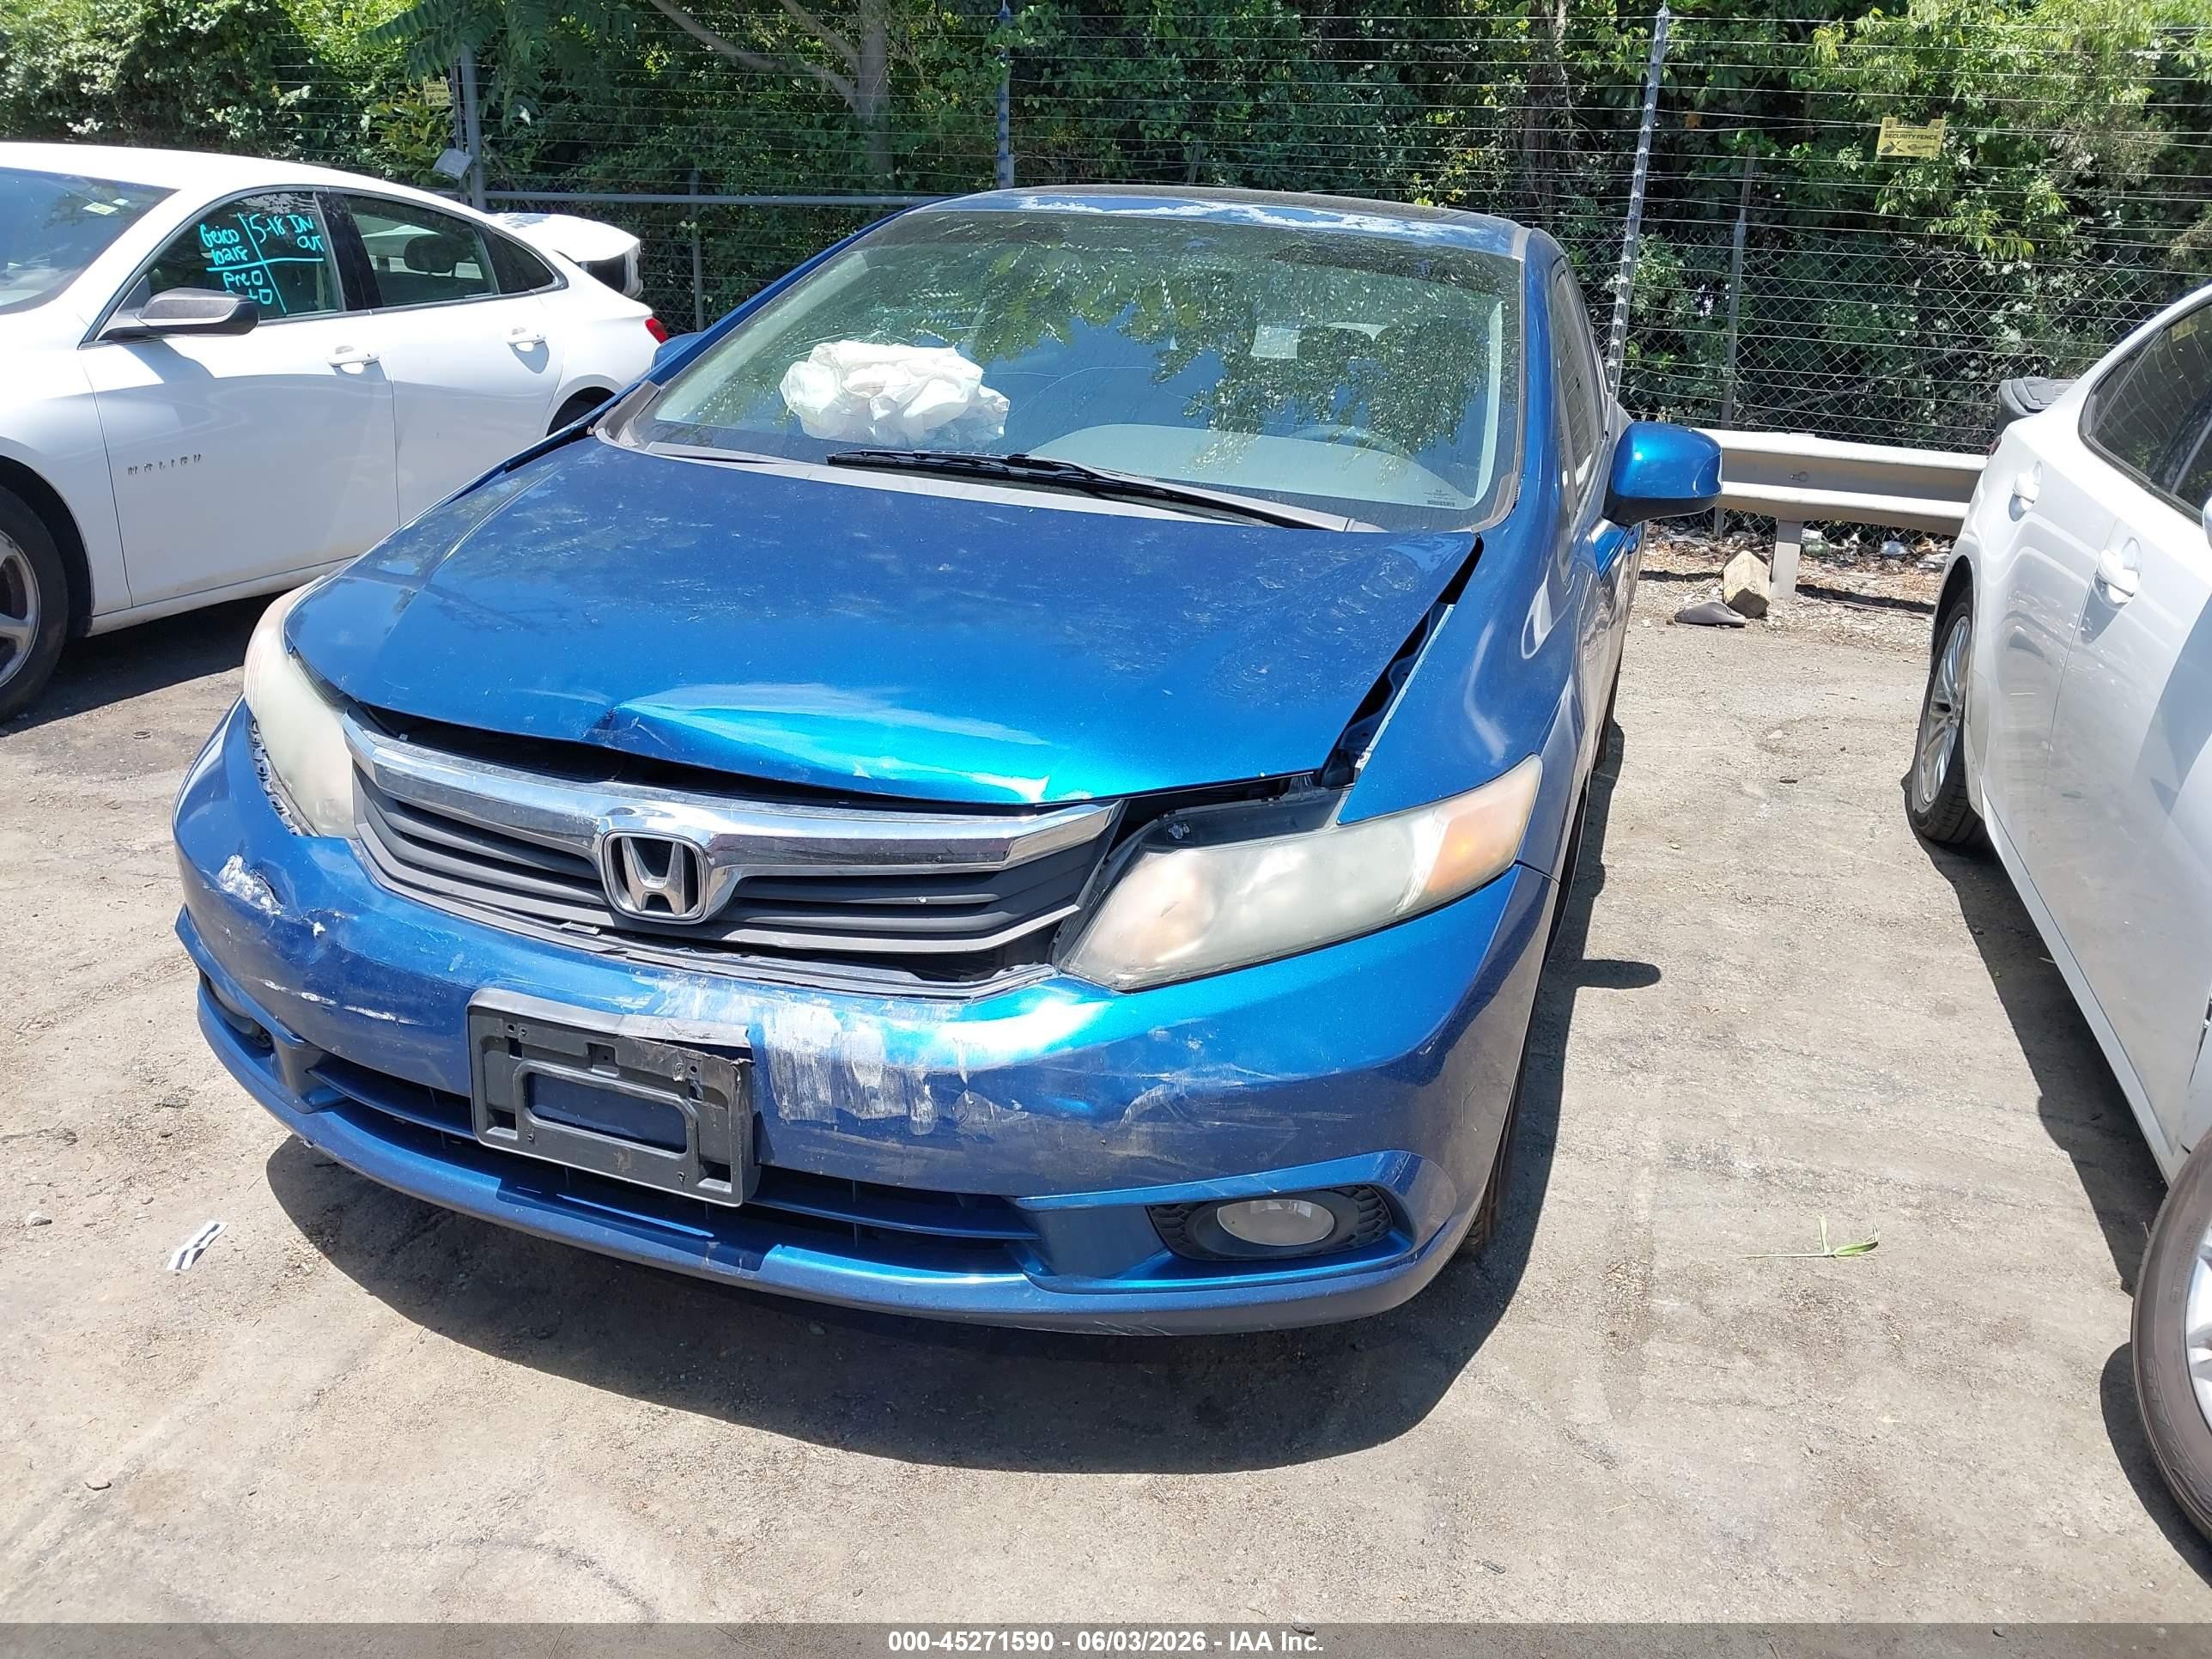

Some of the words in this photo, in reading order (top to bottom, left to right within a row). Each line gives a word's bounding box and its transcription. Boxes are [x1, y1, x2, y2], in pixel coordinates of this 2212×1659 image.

[199, 223, 240, 248] Geico
[248, 213, 286, 244] 5-18
[287, 215, 314, 234] IN
